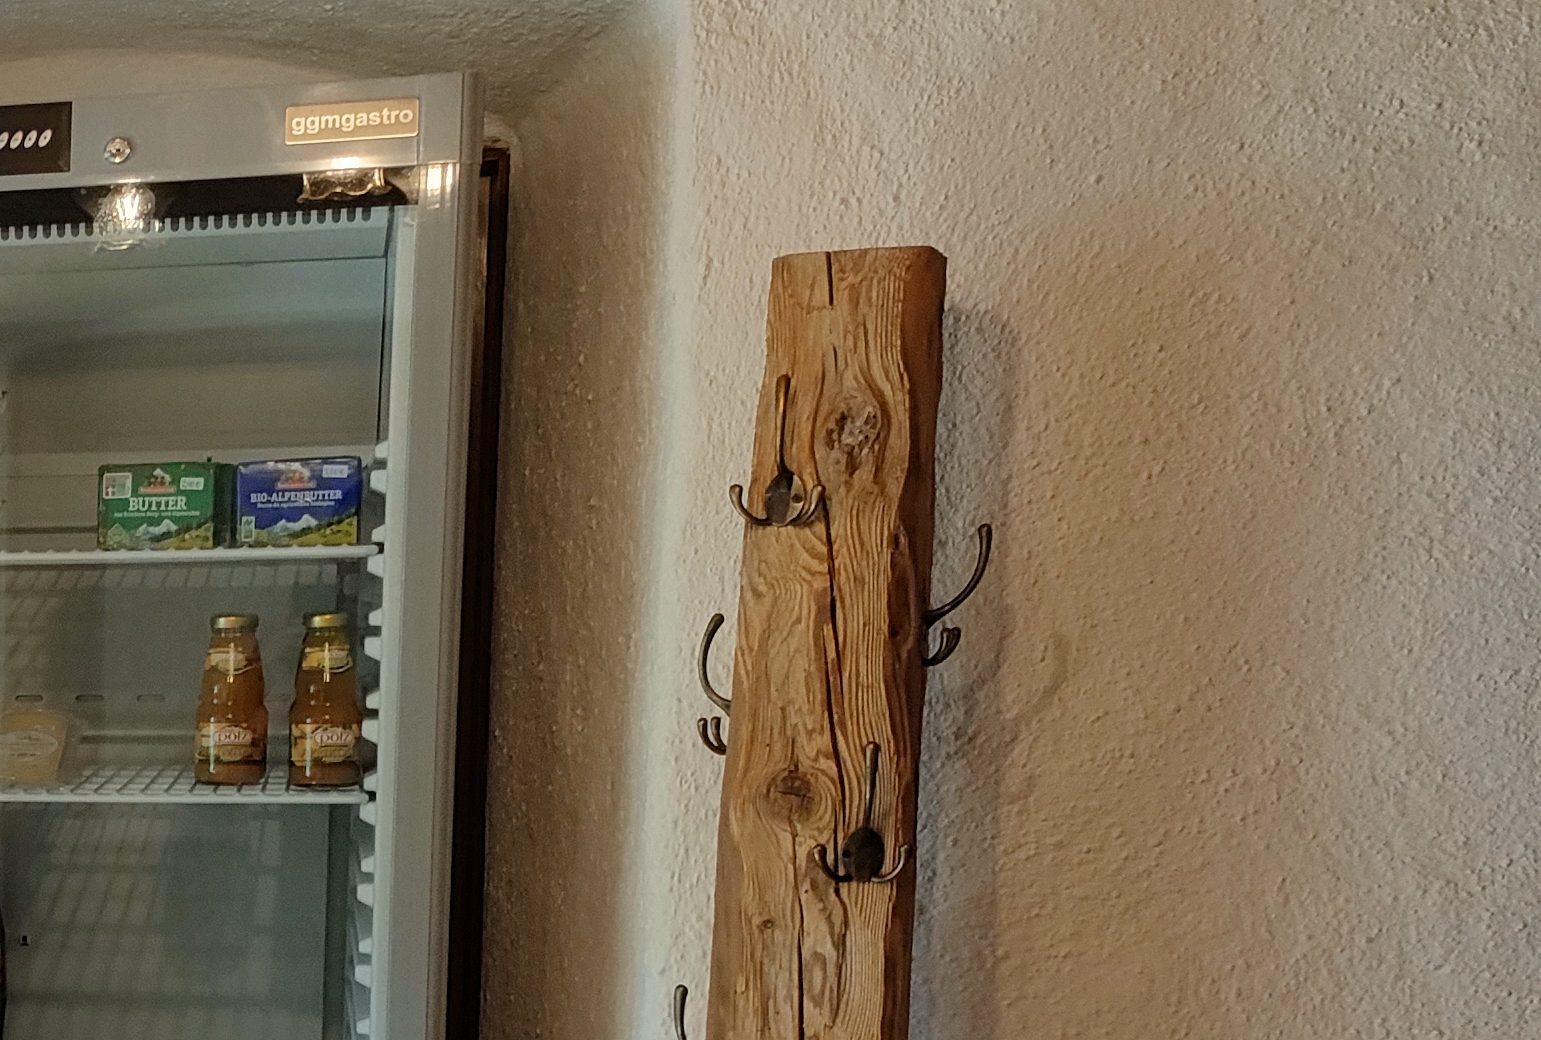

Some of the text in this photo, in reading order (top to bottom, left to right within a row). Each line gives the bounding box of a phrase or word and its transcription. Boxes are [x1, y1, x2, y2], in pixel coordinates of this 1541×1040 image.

[291, 107, 414, 136] ggmgastro
[128, 495, 188, 511] BUTTER
[250, 489, 343, 503] BIO-ALPENBUTTER
